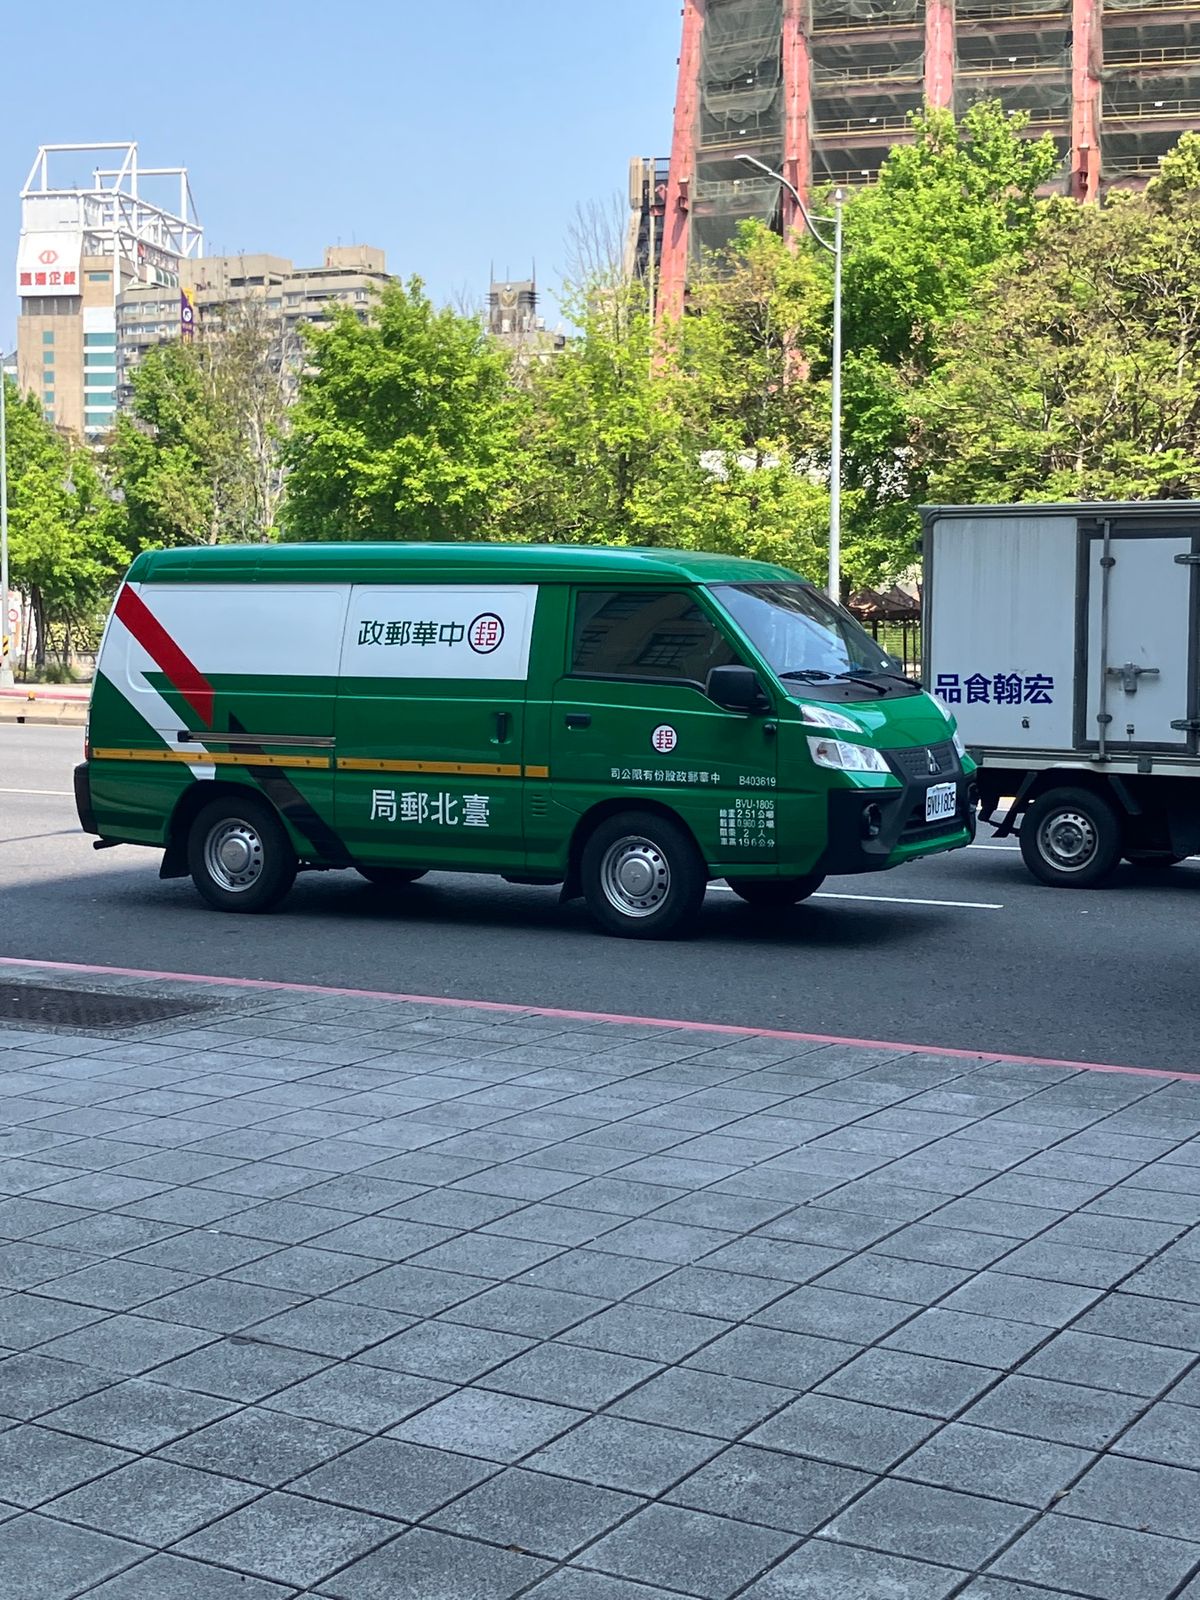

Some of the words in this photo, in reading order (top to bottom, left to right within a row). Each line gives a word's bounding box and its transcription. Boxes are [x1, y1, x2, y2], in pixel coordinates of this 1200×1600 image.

[357, 620, 465, 647] 中華郵政
[934, 673, 1054, 705] 宏翰食品
[739, 775, 776, 787] B403619
[369, 788, 490, 828] 臺北郵局
[735, 798, 775, 810] BVU-1805
[927, 791, 956, 816] BVU-1805
[743, 828, 750, 838] 2
